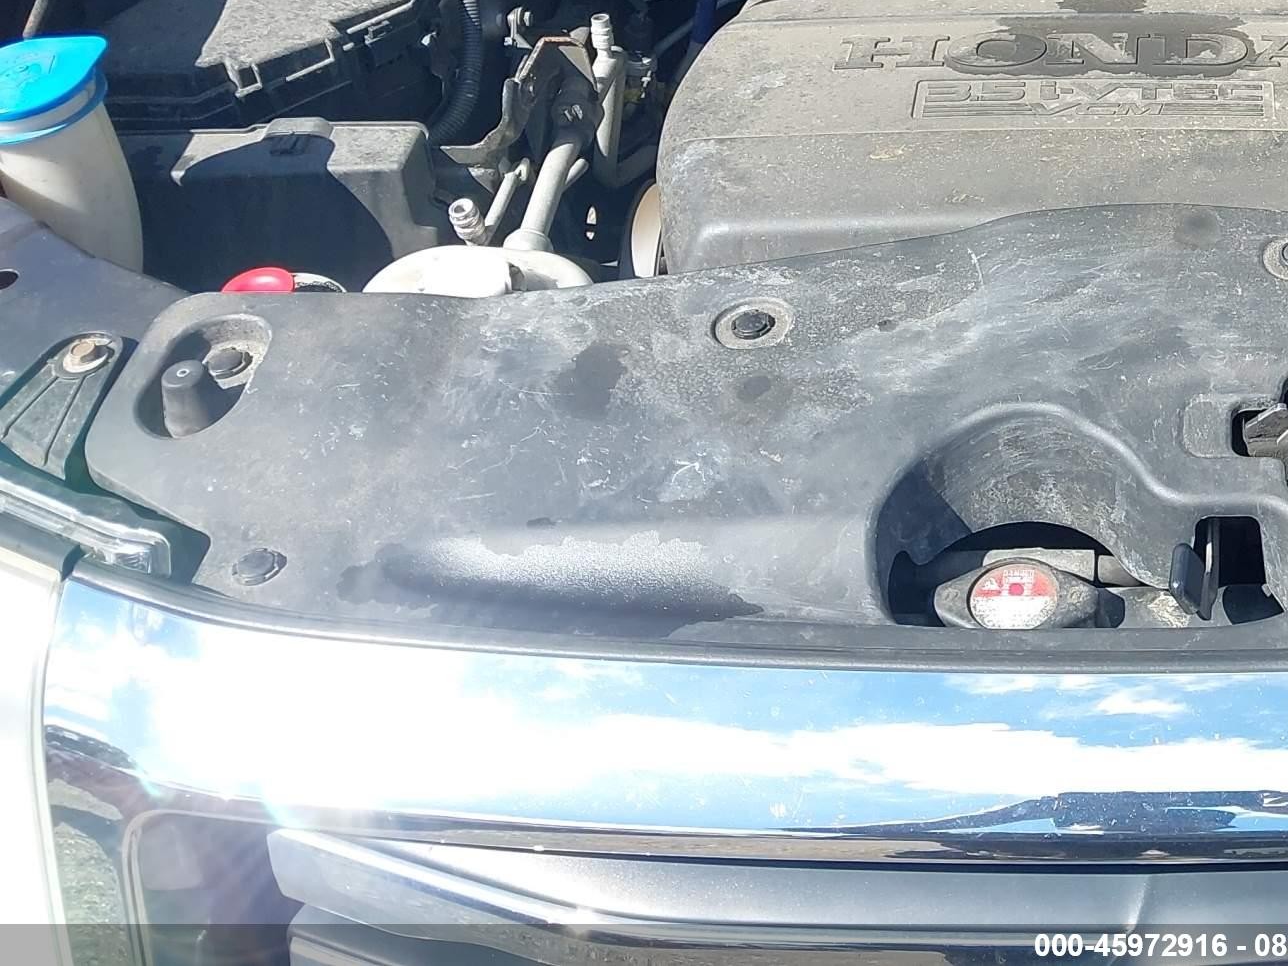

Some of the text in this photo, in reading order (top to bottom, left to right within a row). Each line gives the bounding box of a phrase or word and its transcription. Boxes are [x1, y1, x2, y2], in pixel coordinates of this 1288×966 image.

[924, 80, 1264, 102] 3.5 i-VTEC
[1029, 102, 1164, 116] VCM
